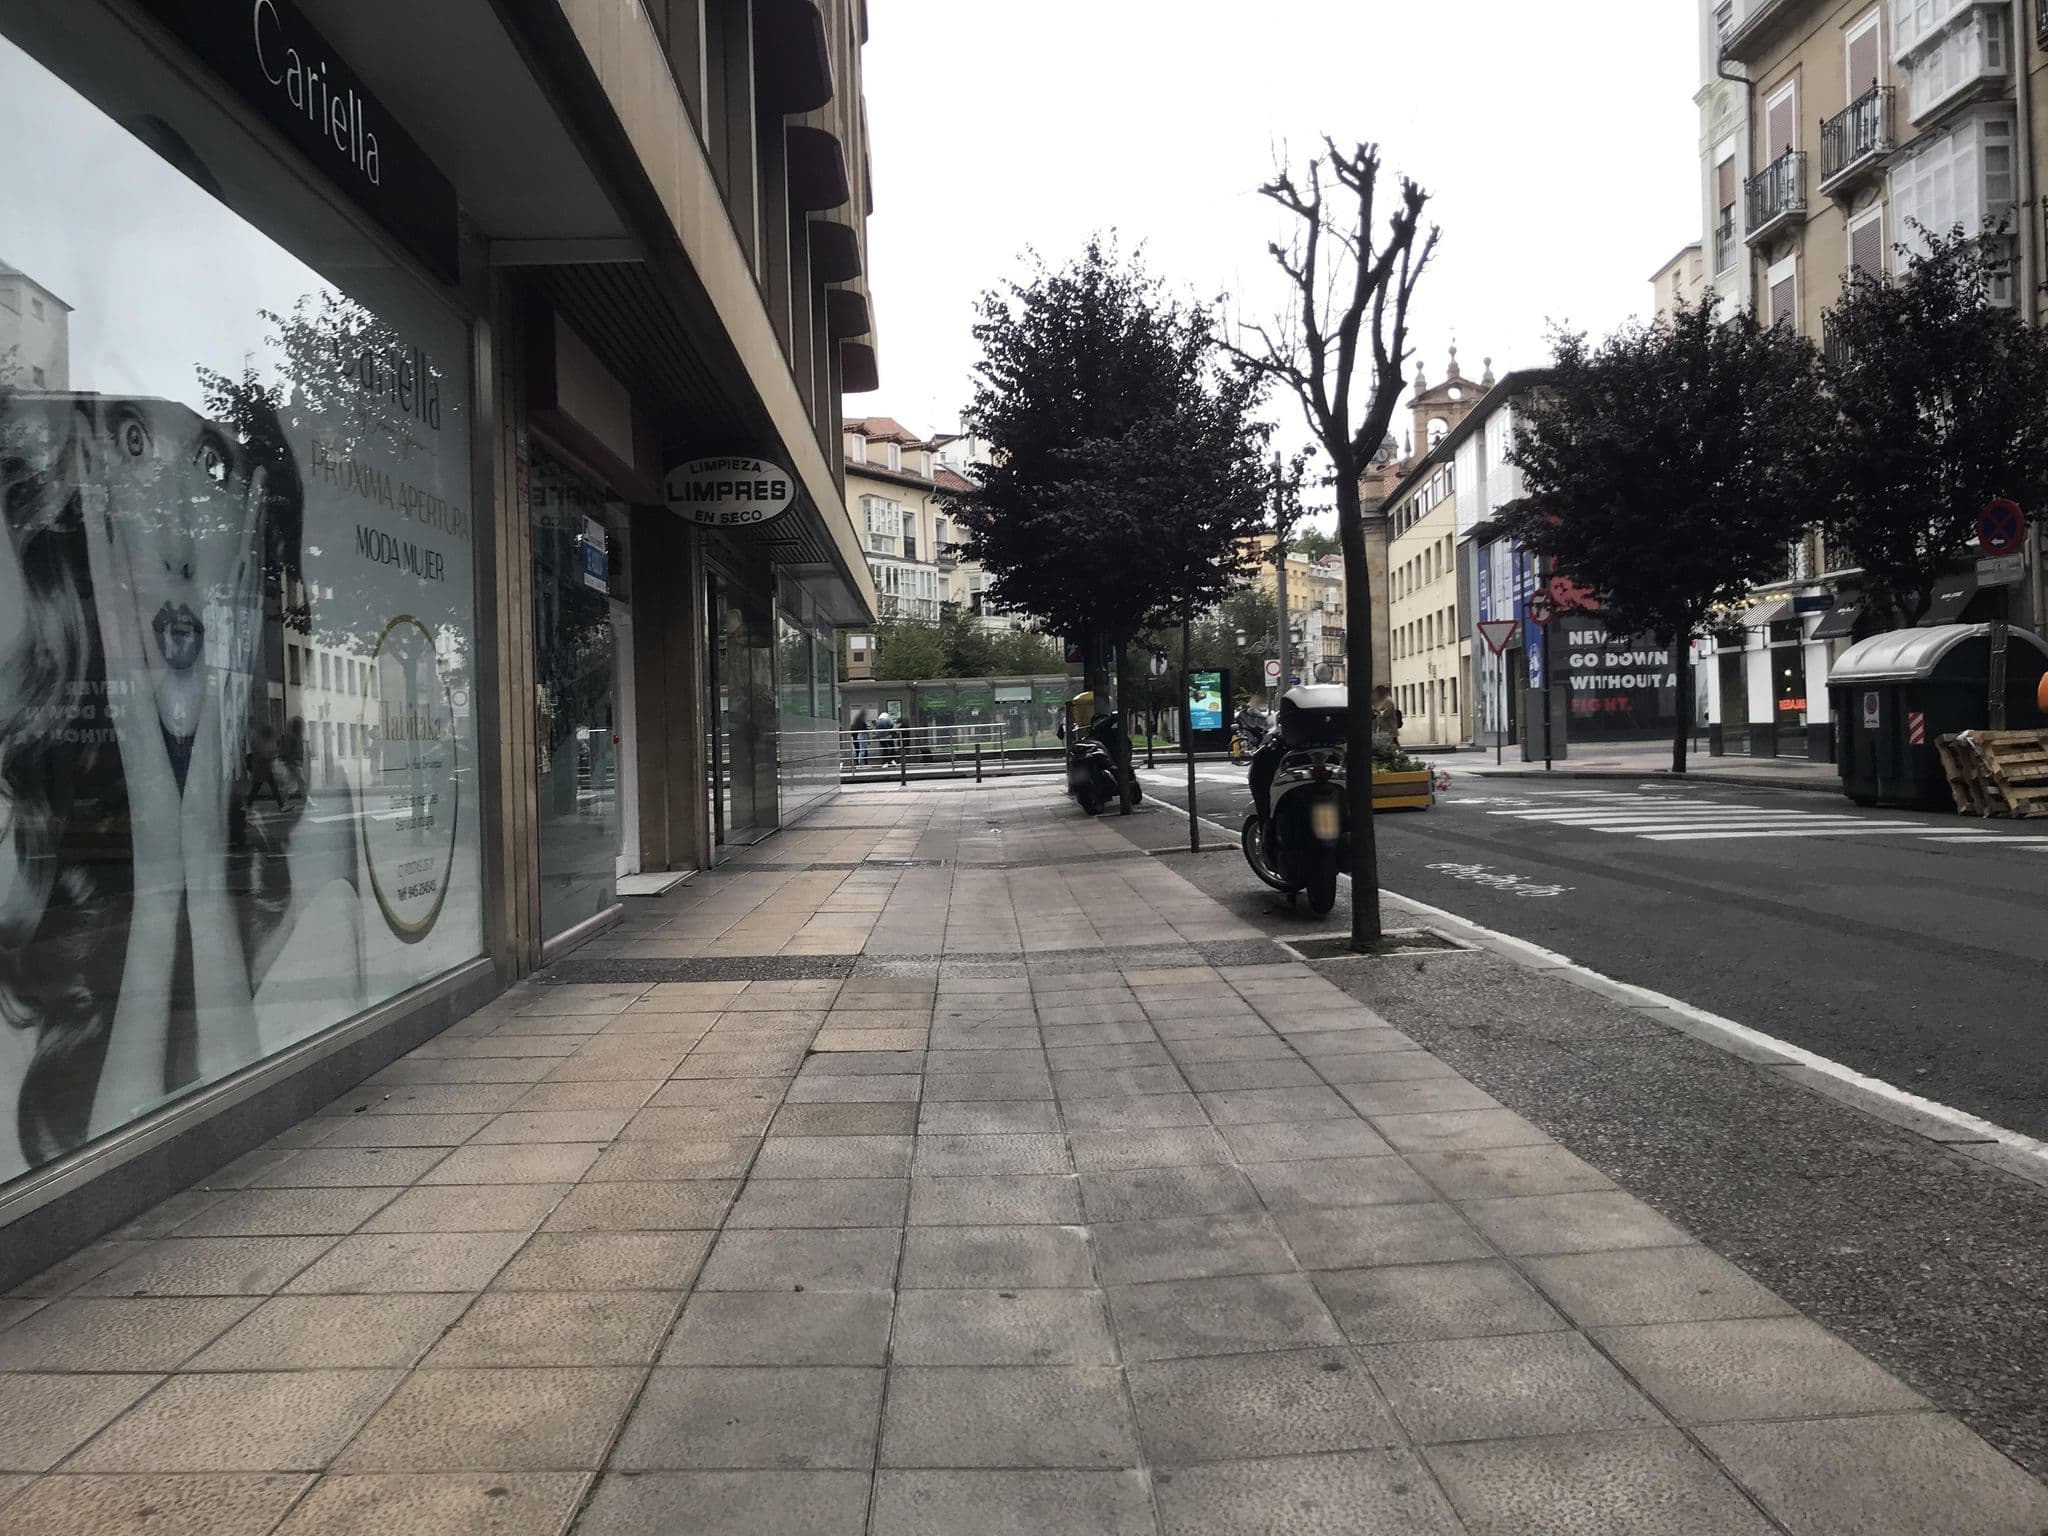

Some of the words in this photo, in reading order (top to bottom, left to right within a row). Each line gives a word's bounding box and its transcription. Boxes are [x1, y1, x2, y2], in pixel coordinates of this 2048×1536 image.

[254, 0, 380, 186] Cariella
[690, 460, 762, 474] LIMPIEZA
[667, 480, 787, 502] LIMPRES
[695, 510, 715, 523] EN
[720, 509, 762, 524] SECO
[356, 524, 401, 569] MODA
[402, 541, 445, 582] MUJER
[1569, 653, 1599, 668] GO
[1604, 650, 1669, 667] DOWN
[1569, 673, 1662, 690] WITHOUT
[1665, 672, 1678, 688] A
